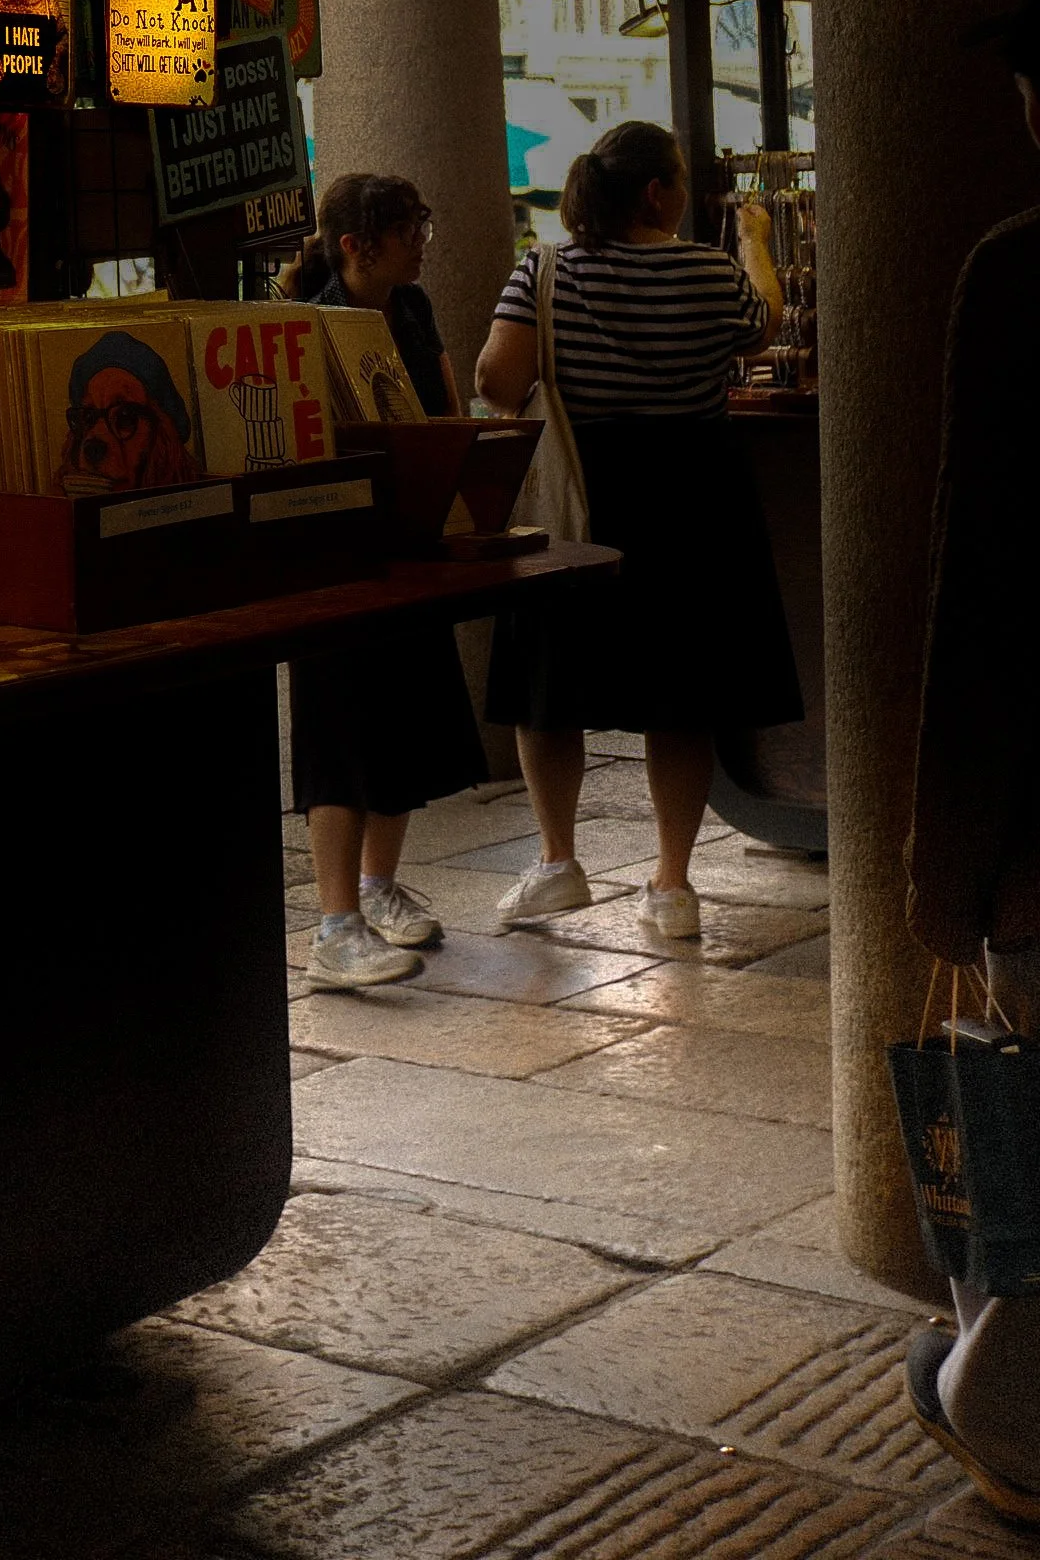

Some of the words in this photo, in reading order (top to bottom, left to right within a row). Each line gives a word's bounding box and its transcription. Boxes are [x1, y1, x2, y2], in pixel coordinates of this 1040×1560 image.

[111, 9, 130, 28] Do
[135, 10, 164, 31] Not
[171, 11, 214, 33] Knock
[5, 25, 9, 46] I
[12, 26, 40, 47] HATE
[115, 33, 135, 49] They
[136, 34, 151, 47] will
[177, 37, 191, 50] will
[2, 54, 44, 75] PEOPLE
[136, 54, 157, 73] WILL
[159, 55, 172, 74] GET
[173, 56, 191, 75] REAL
[224, 56, 278, 89] BOSSY,
[171, 117, 179, 150] I
[181, 104, 228, 147] JUST
[231, 91, 281, 133] HAVE
[165, 146, 239, 200] BETTER
[240, 131, 294, 179] IDEAS
[244, 199, 265, 234] BE
[265, 188, 306, 229] HOME
